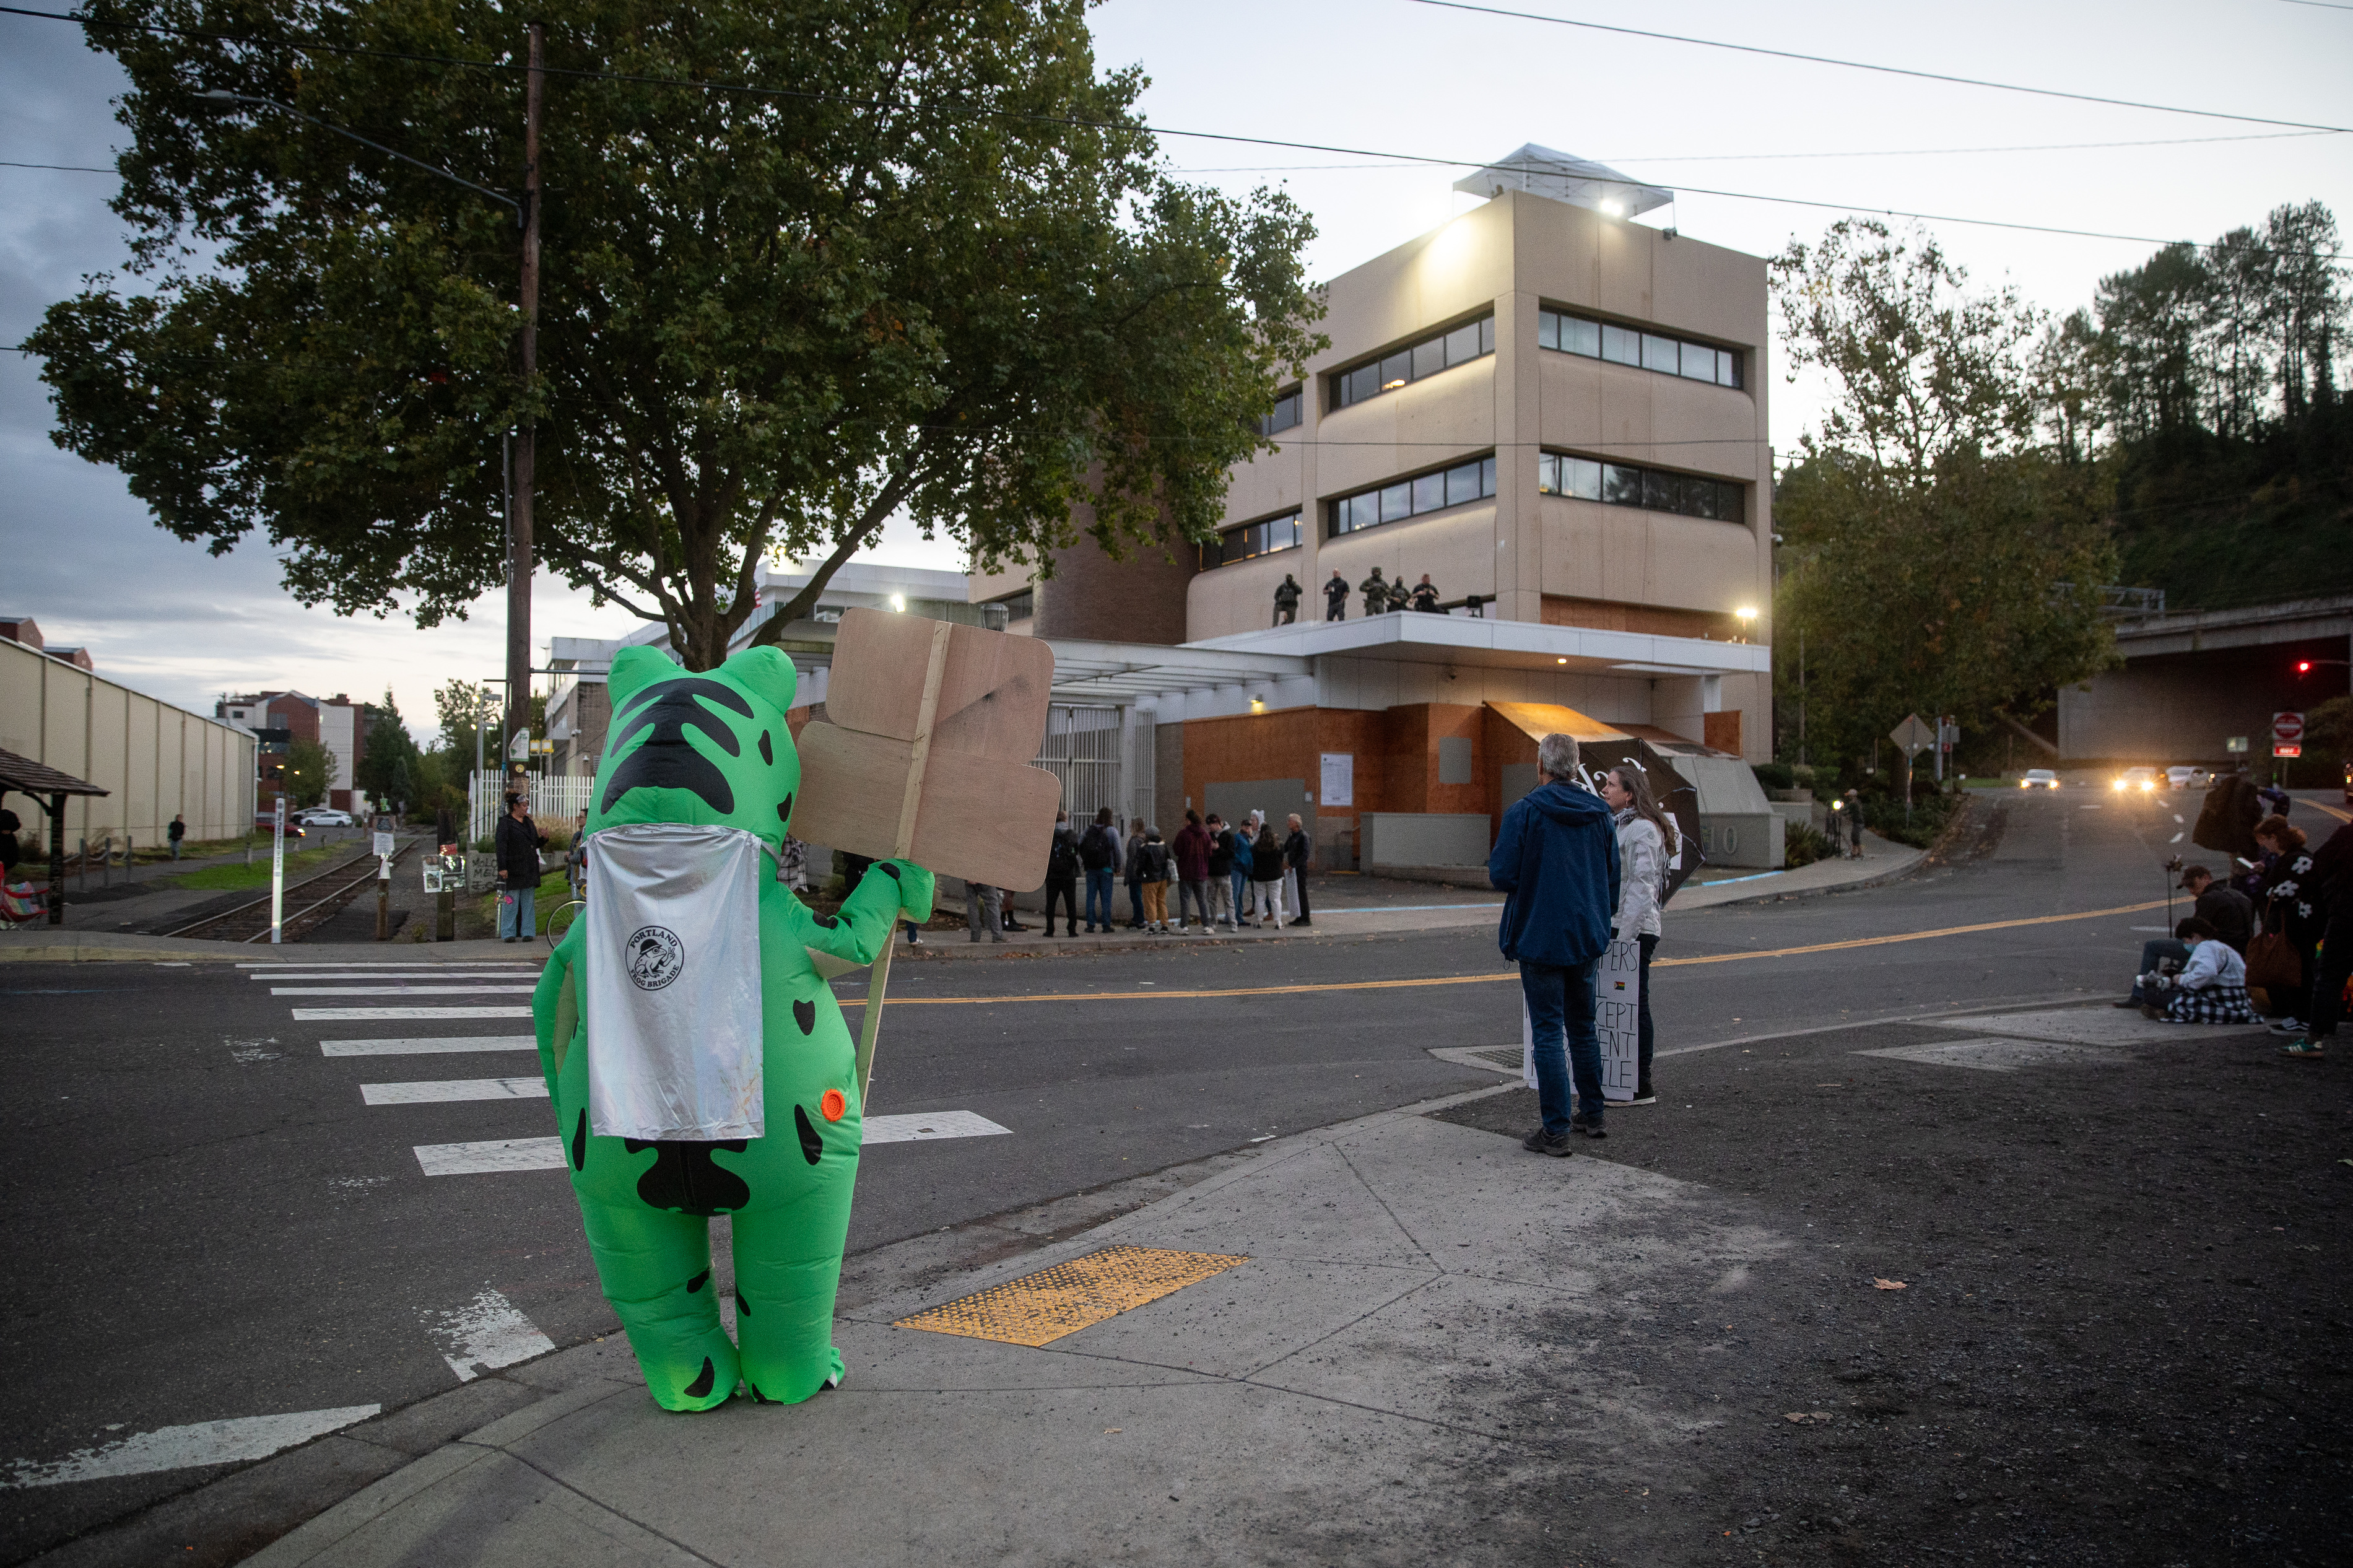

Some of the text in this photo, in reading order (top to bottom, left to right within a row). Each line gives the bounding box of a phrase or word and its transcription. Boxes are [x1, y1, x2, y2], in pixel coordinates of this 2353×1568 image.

[630, 929, 677, 949] PORTLAND
[630, 964, 679, 987] FROG BRIGADE
